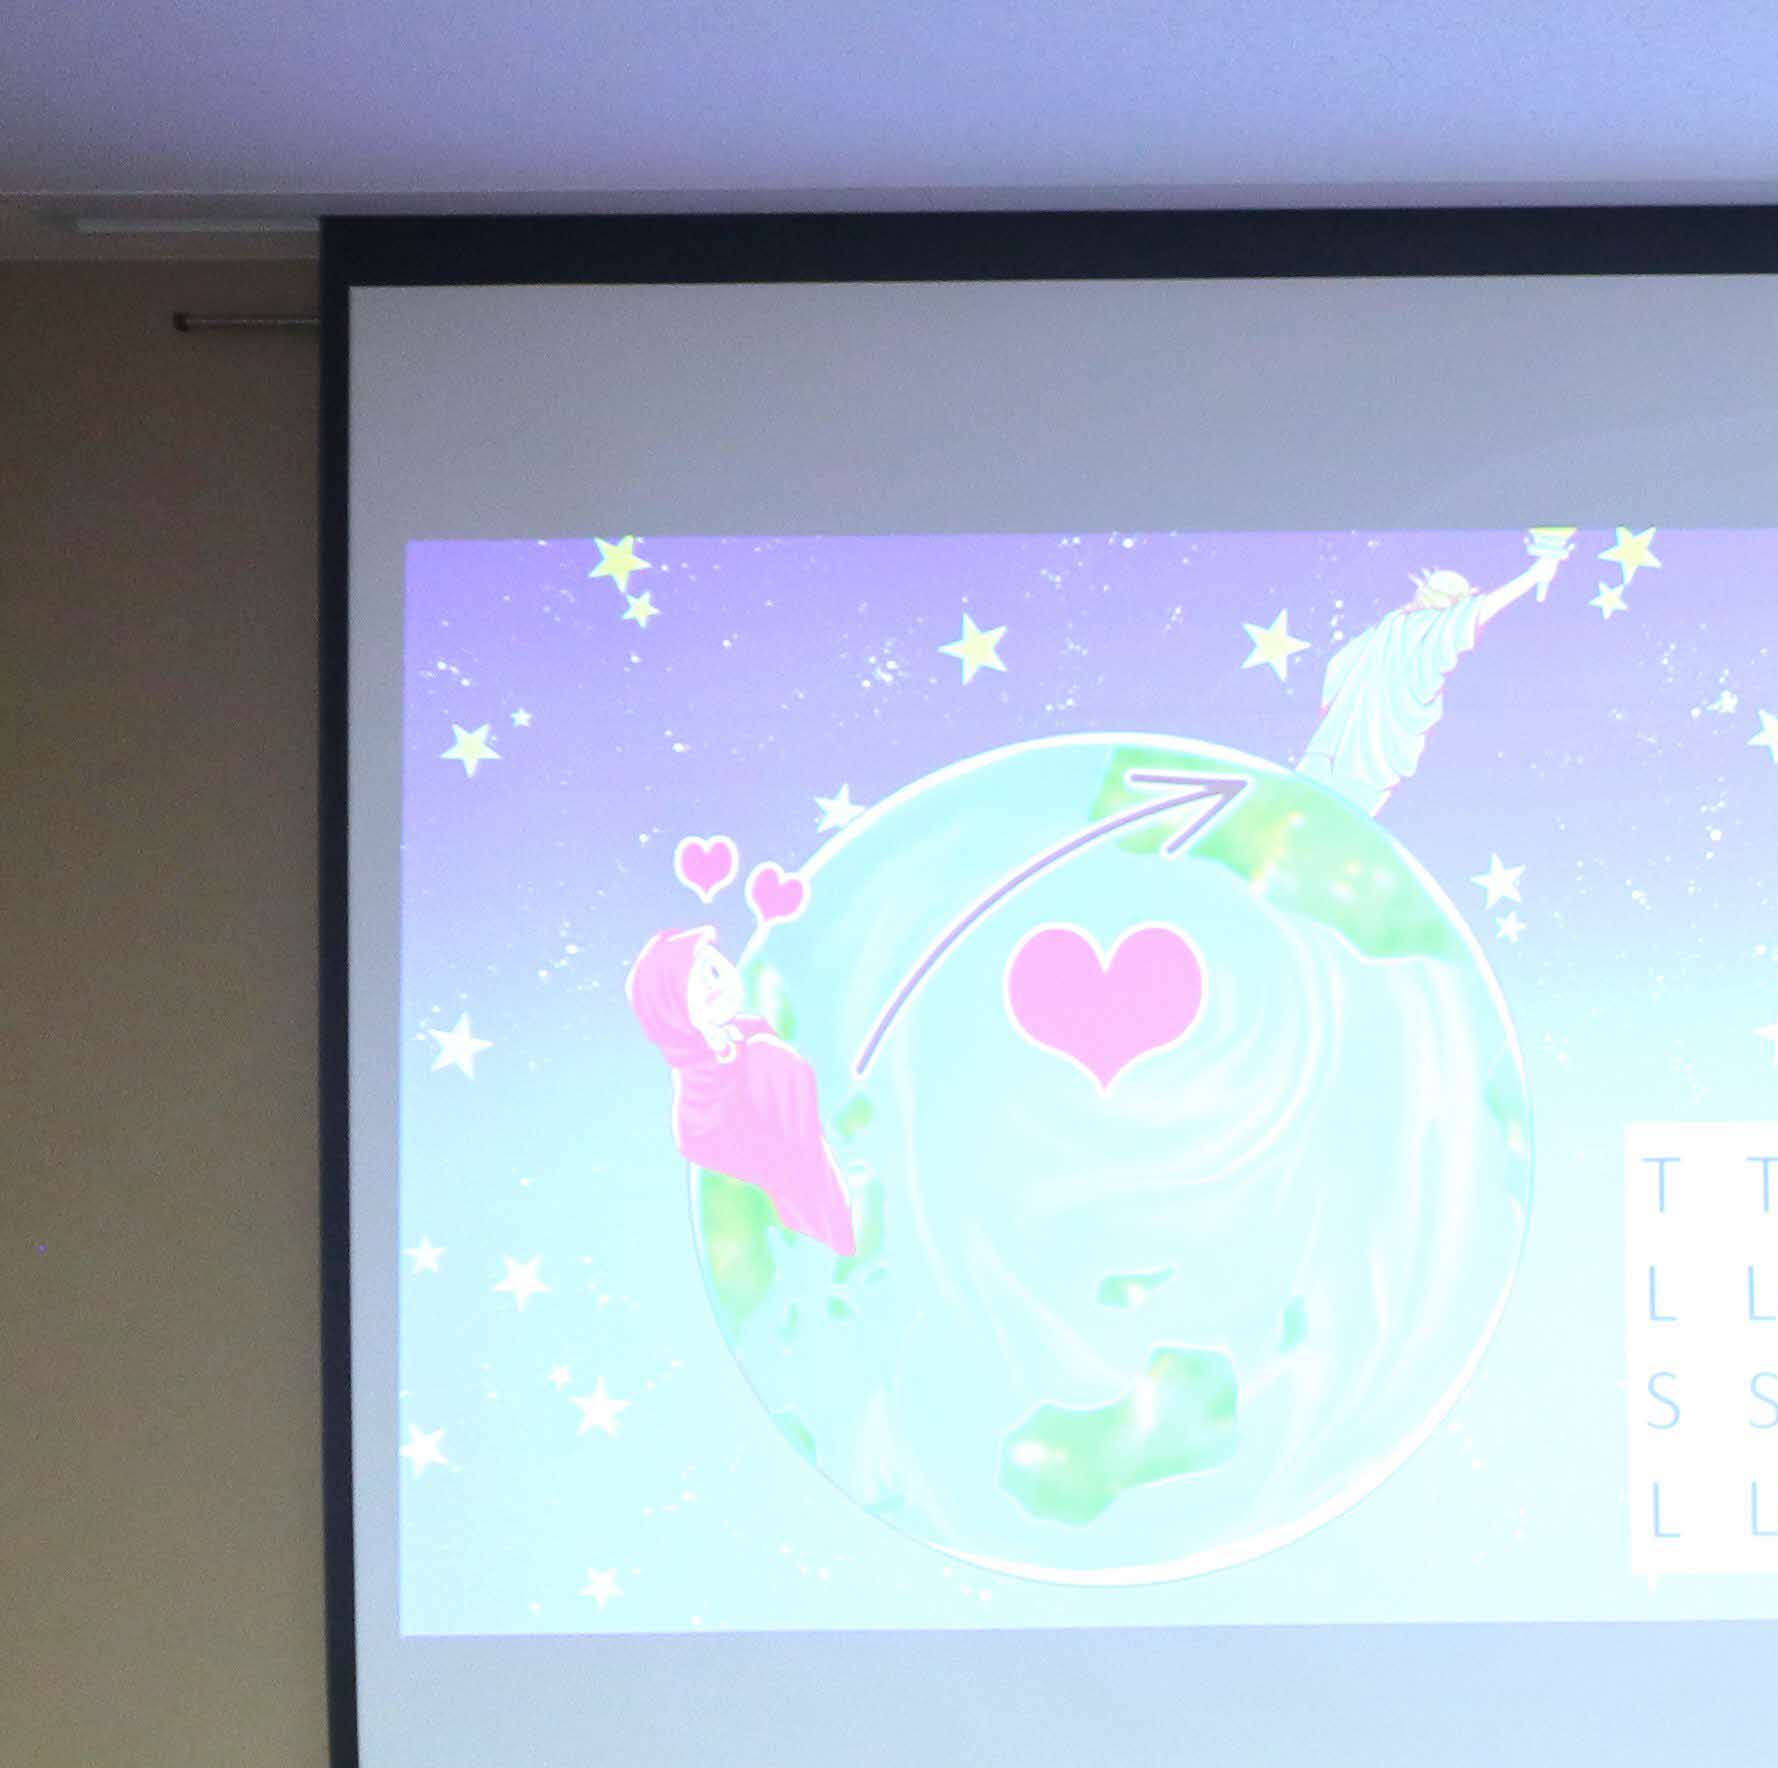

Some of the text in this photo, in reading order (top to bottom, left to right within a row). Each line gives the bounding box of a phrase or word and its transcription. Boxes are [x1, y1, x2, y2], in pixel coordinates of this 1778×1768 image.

[1642, 1157, 1680, 1213] T
[1649, 1264, 1678, 1322] L
[1648, 1372, 1680, 1430] S
[1653, 1482, 1680, 1538] L
